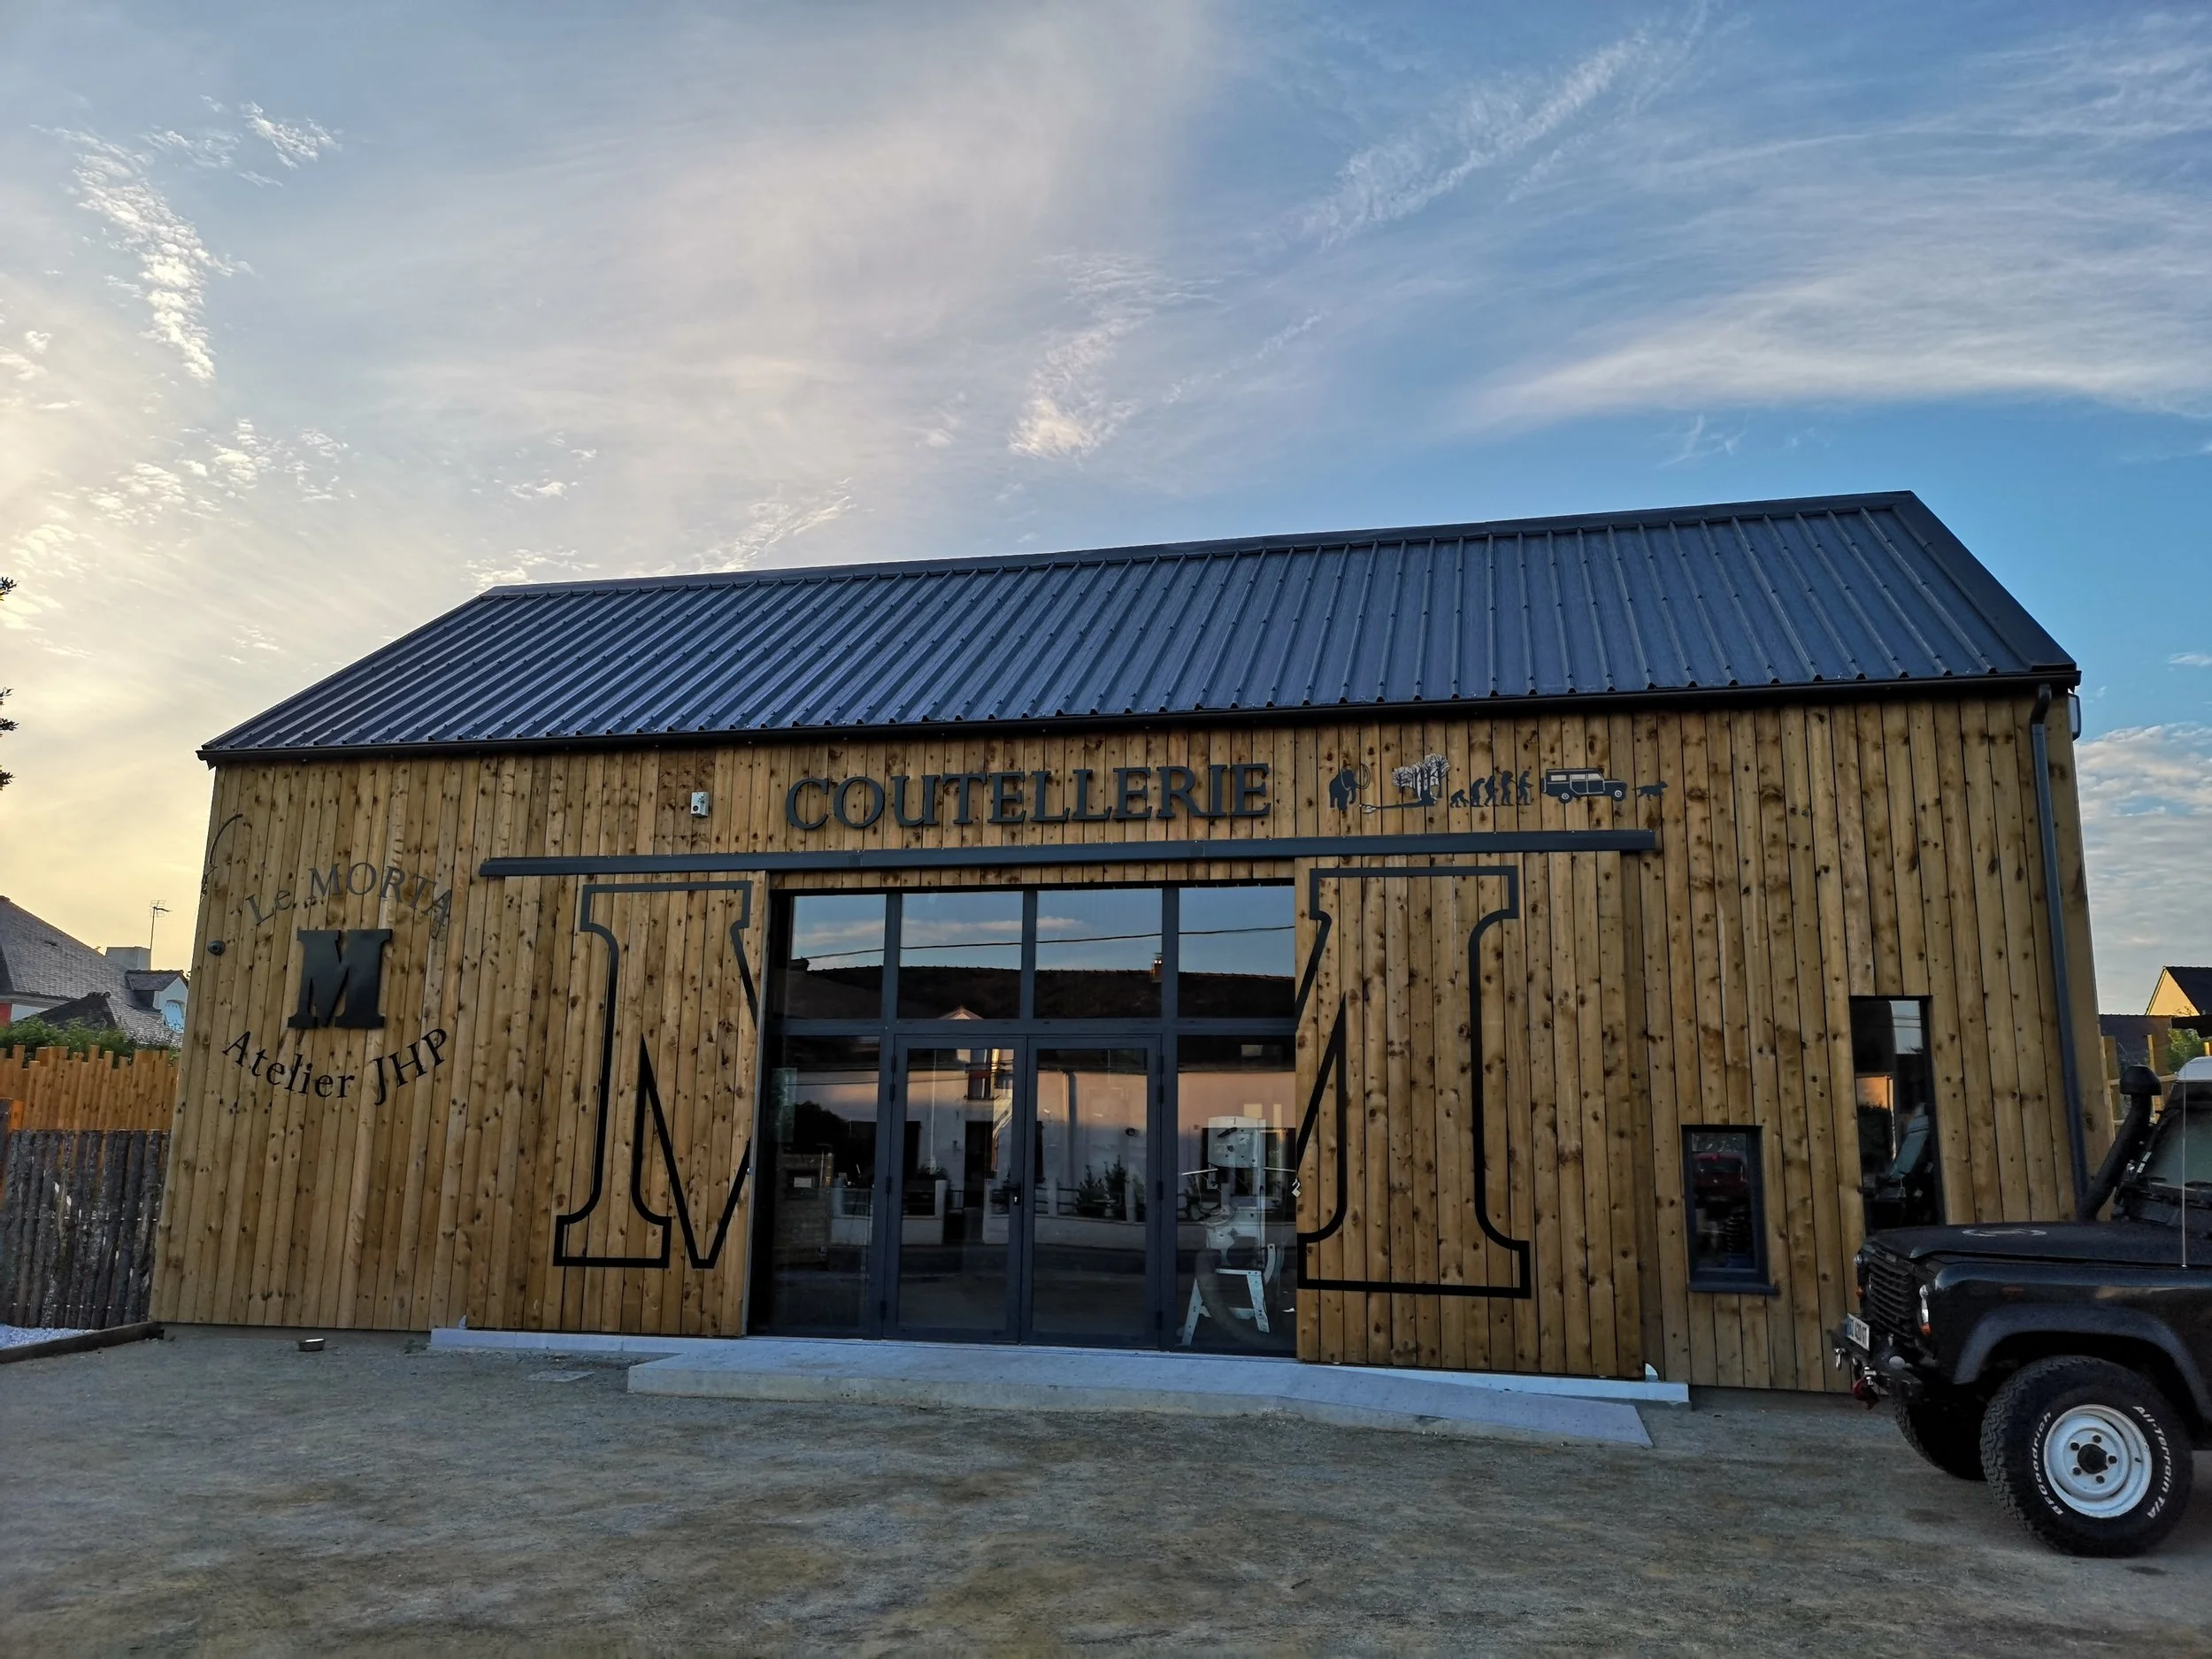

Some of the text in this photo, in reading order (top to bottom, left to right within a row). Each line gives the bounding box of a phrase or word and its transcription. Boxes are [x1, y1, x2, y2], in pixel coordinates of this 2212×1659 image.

[785, 763, 1272, 831] COUTELLERIE
[245, 862, 453, 927] Le MORTA
[287, 929, 393, 1030] M
[221, 1028, 448, 1106] Atelier JHP
